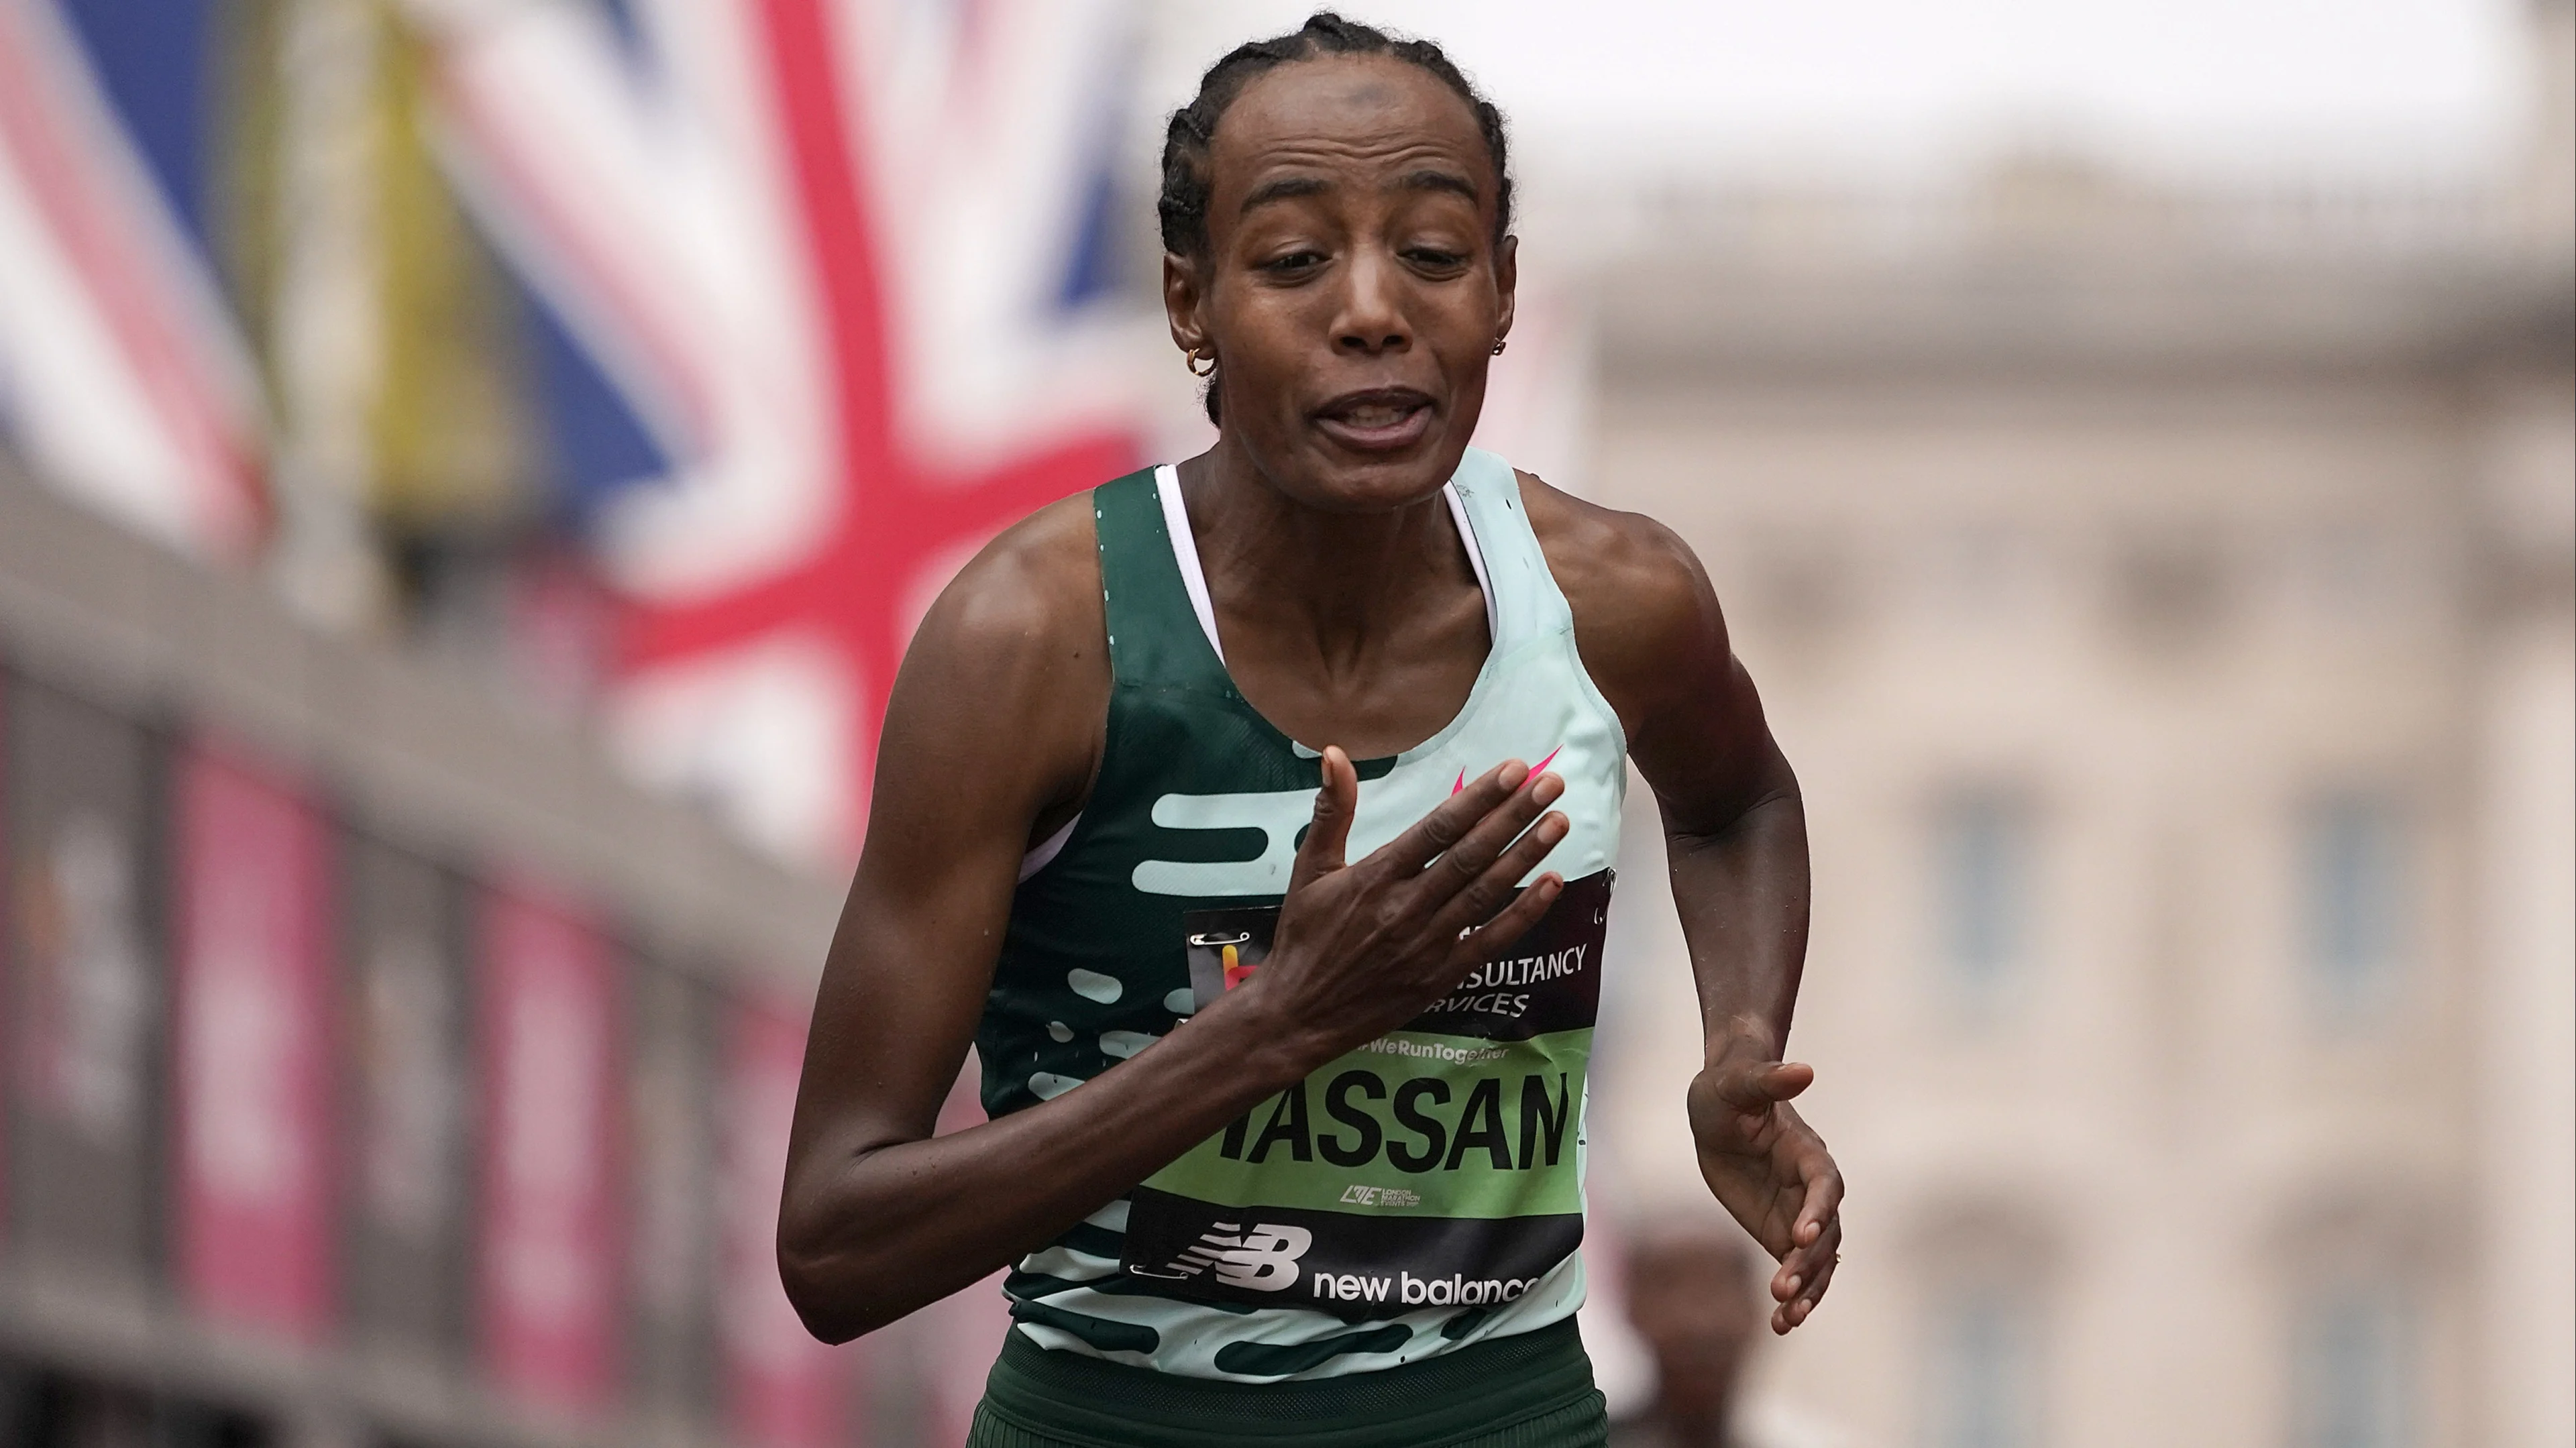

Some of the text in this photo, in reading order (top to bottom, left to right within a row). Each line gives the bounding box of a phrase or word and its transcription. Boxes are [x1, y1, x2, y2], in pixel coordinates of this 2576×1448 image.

[1457, 944, 1588, 990] SULTANCY
[1424, 992, 1529, 1018] RVICES
[1381, 1194, 1421, 1202] MARATHON
[1382, 1188, 1411, 1196] LONDON
[1313, 1272, 1391, 1302] new
